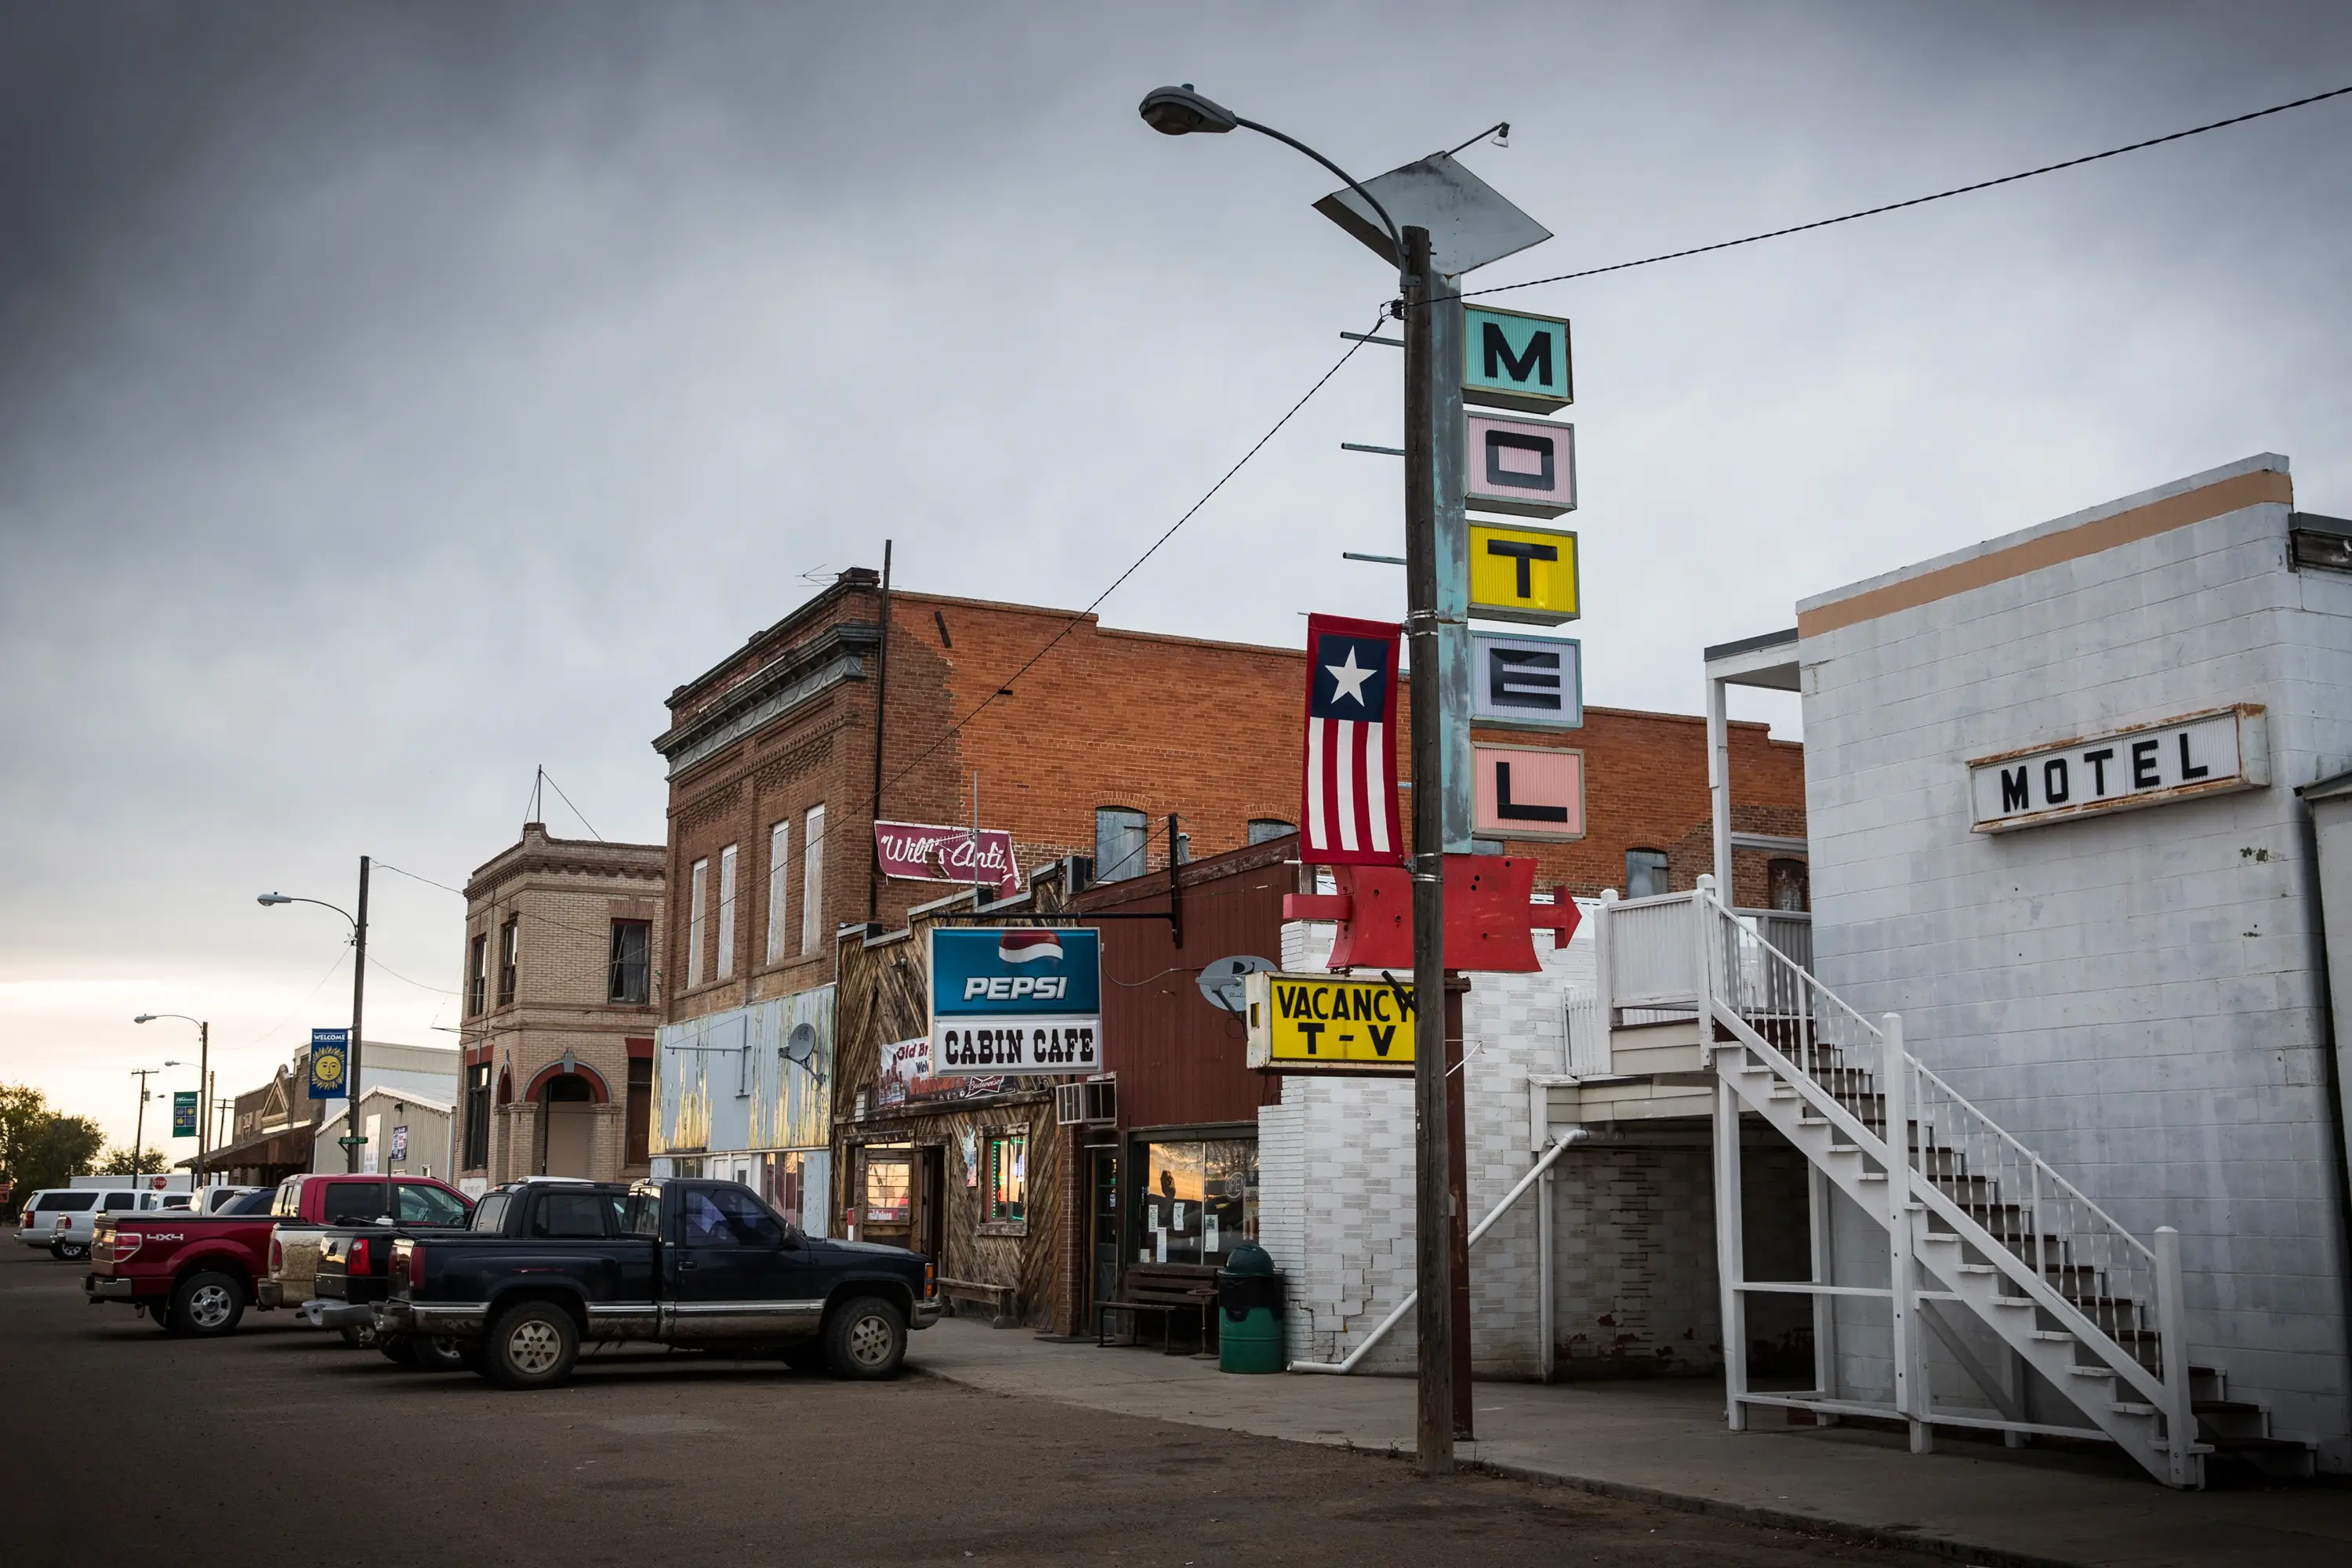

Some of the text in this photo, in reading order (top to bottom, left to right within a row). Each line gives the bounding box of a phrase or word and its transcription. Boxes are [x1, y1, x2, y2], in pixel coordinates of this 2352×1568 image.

[1483, 321, 1567, 823] MOTEL
[2001, 733, 2209, 813] MOTEL
[963, 976, 1069, 1001] PEPSI
[1276, 985, 1415, 1022] VACANCY
[945, 1029, 1094, 1065] CABIN CAFE
[1225, 1176, 1246, 1193] OPEN
